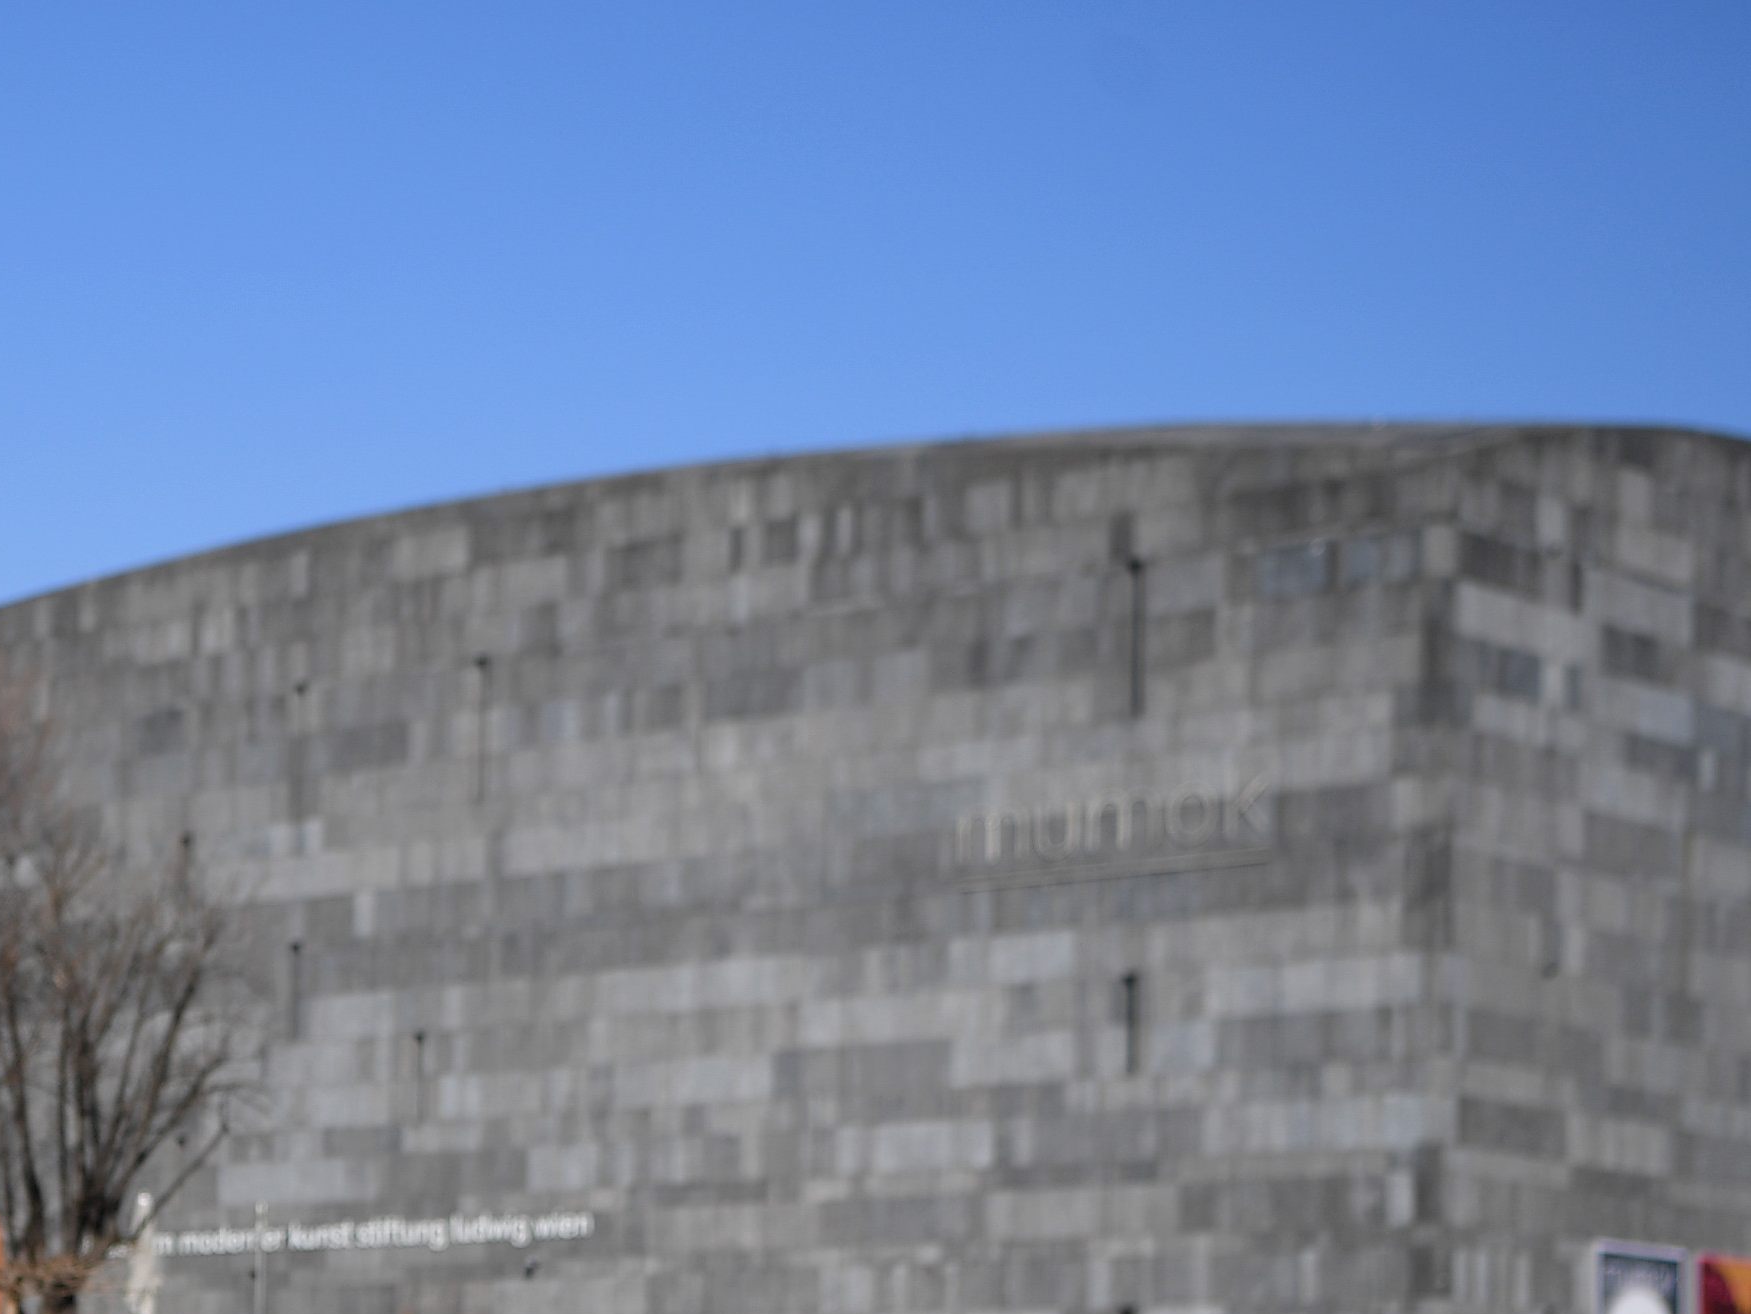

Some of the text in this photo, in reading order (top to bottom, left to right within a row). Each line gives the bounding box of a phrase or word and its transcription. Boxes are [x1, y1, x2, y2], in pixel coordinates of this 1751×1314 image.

[954, 770, 1272, 866] mumok
[288, 1218, 354, 1250] kunst
[356, 1215, 447, 1251] stiftung
[450, 1212, 532, 1248] ludwig
[534, 1210, 595, 1240] wien
